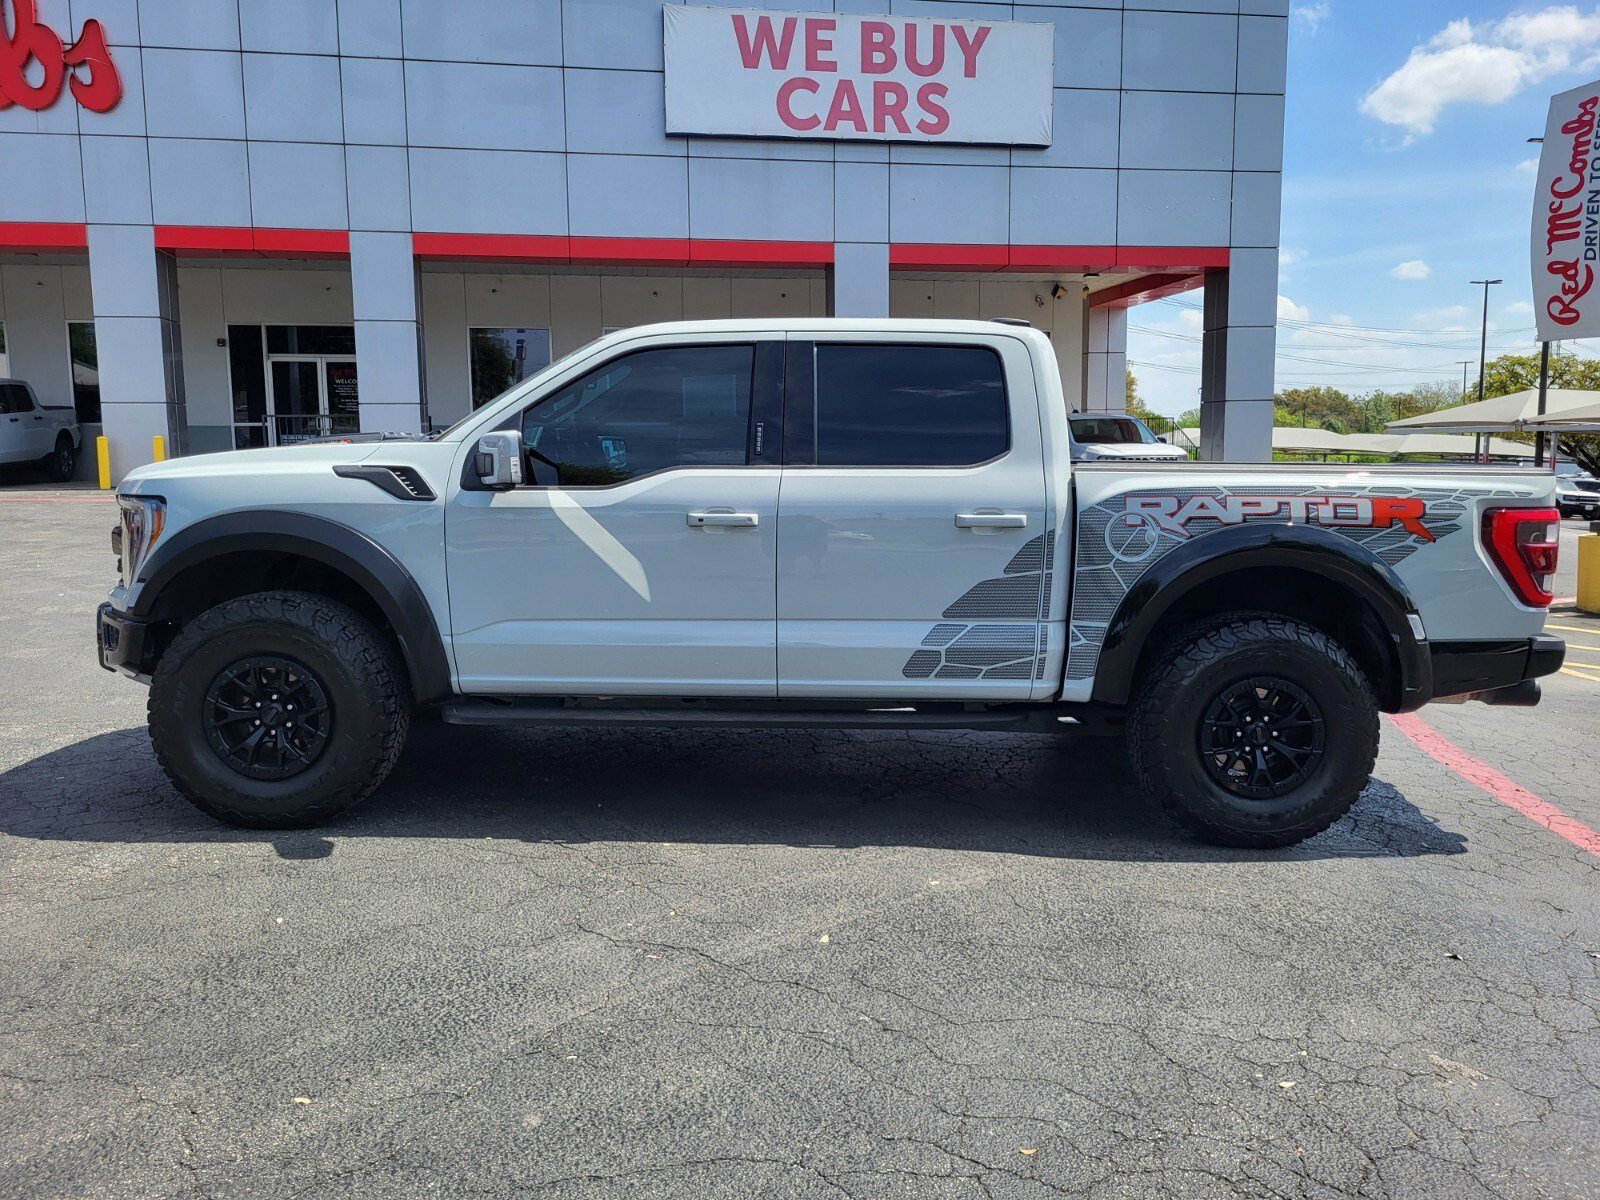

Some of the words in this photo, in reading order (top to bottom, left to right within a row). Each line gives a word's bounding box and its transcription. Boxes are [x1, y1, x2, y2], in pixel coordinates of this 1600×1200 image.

[730, 14, 838, 73] WE
[860, 20, 992, 79] BUY
[775, 76, 951, 136] CARS
[1589, 156, 1600, 184] TO
[1584, 190, 1600, 261] DRIVEN
[1546, 256, 1594, 326] Red
[1124, 495, 1437, 544] RAPTOR
